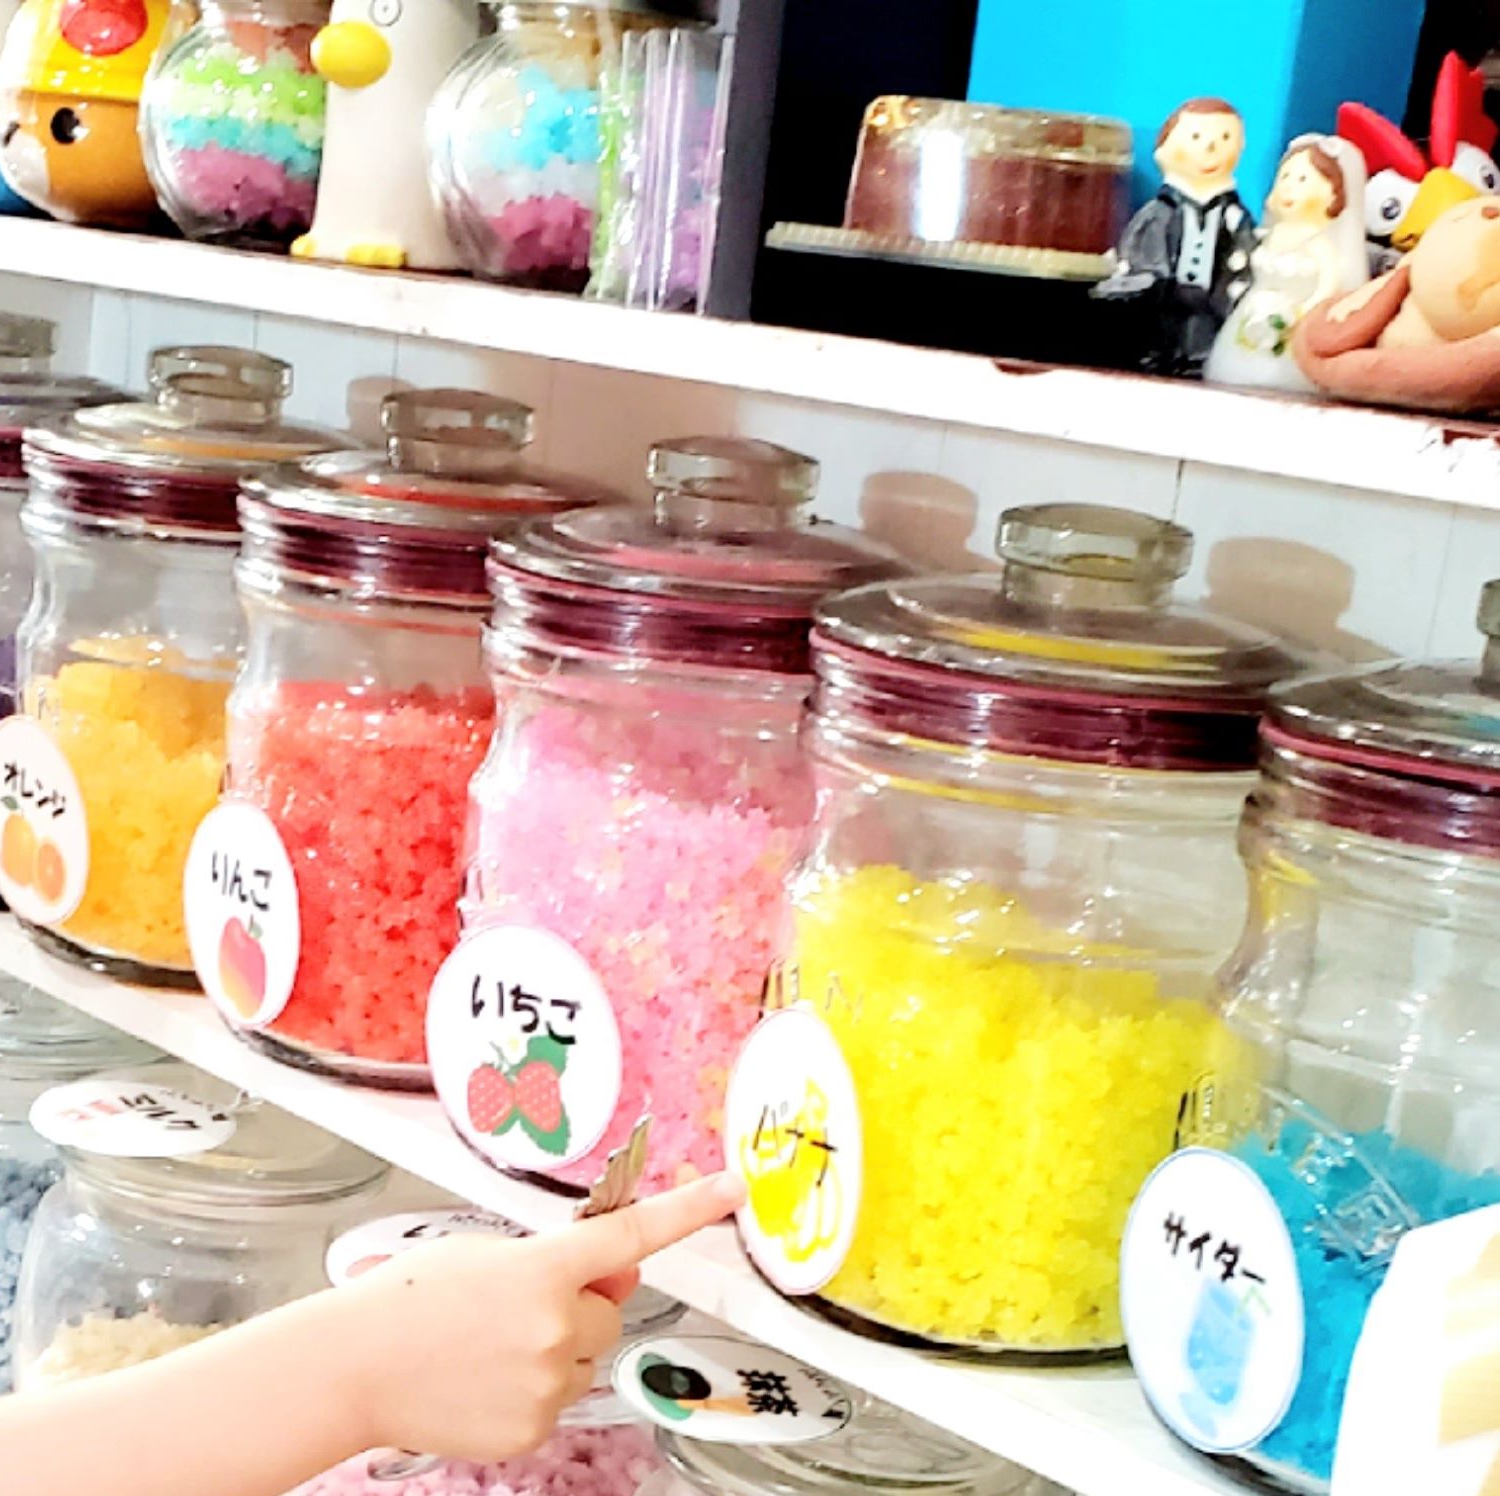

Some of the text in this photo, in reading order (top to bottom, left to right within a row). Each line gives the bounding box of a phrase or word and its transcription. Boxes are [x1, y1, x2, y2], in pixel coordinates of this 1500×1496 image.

[4, 760, 66, 819] オレンジ
[471, 973, 581, 1045] いちご
[119, 1094, 201, 1130] ミルク
[1163, 1210, 1266, 1285] サイダー
